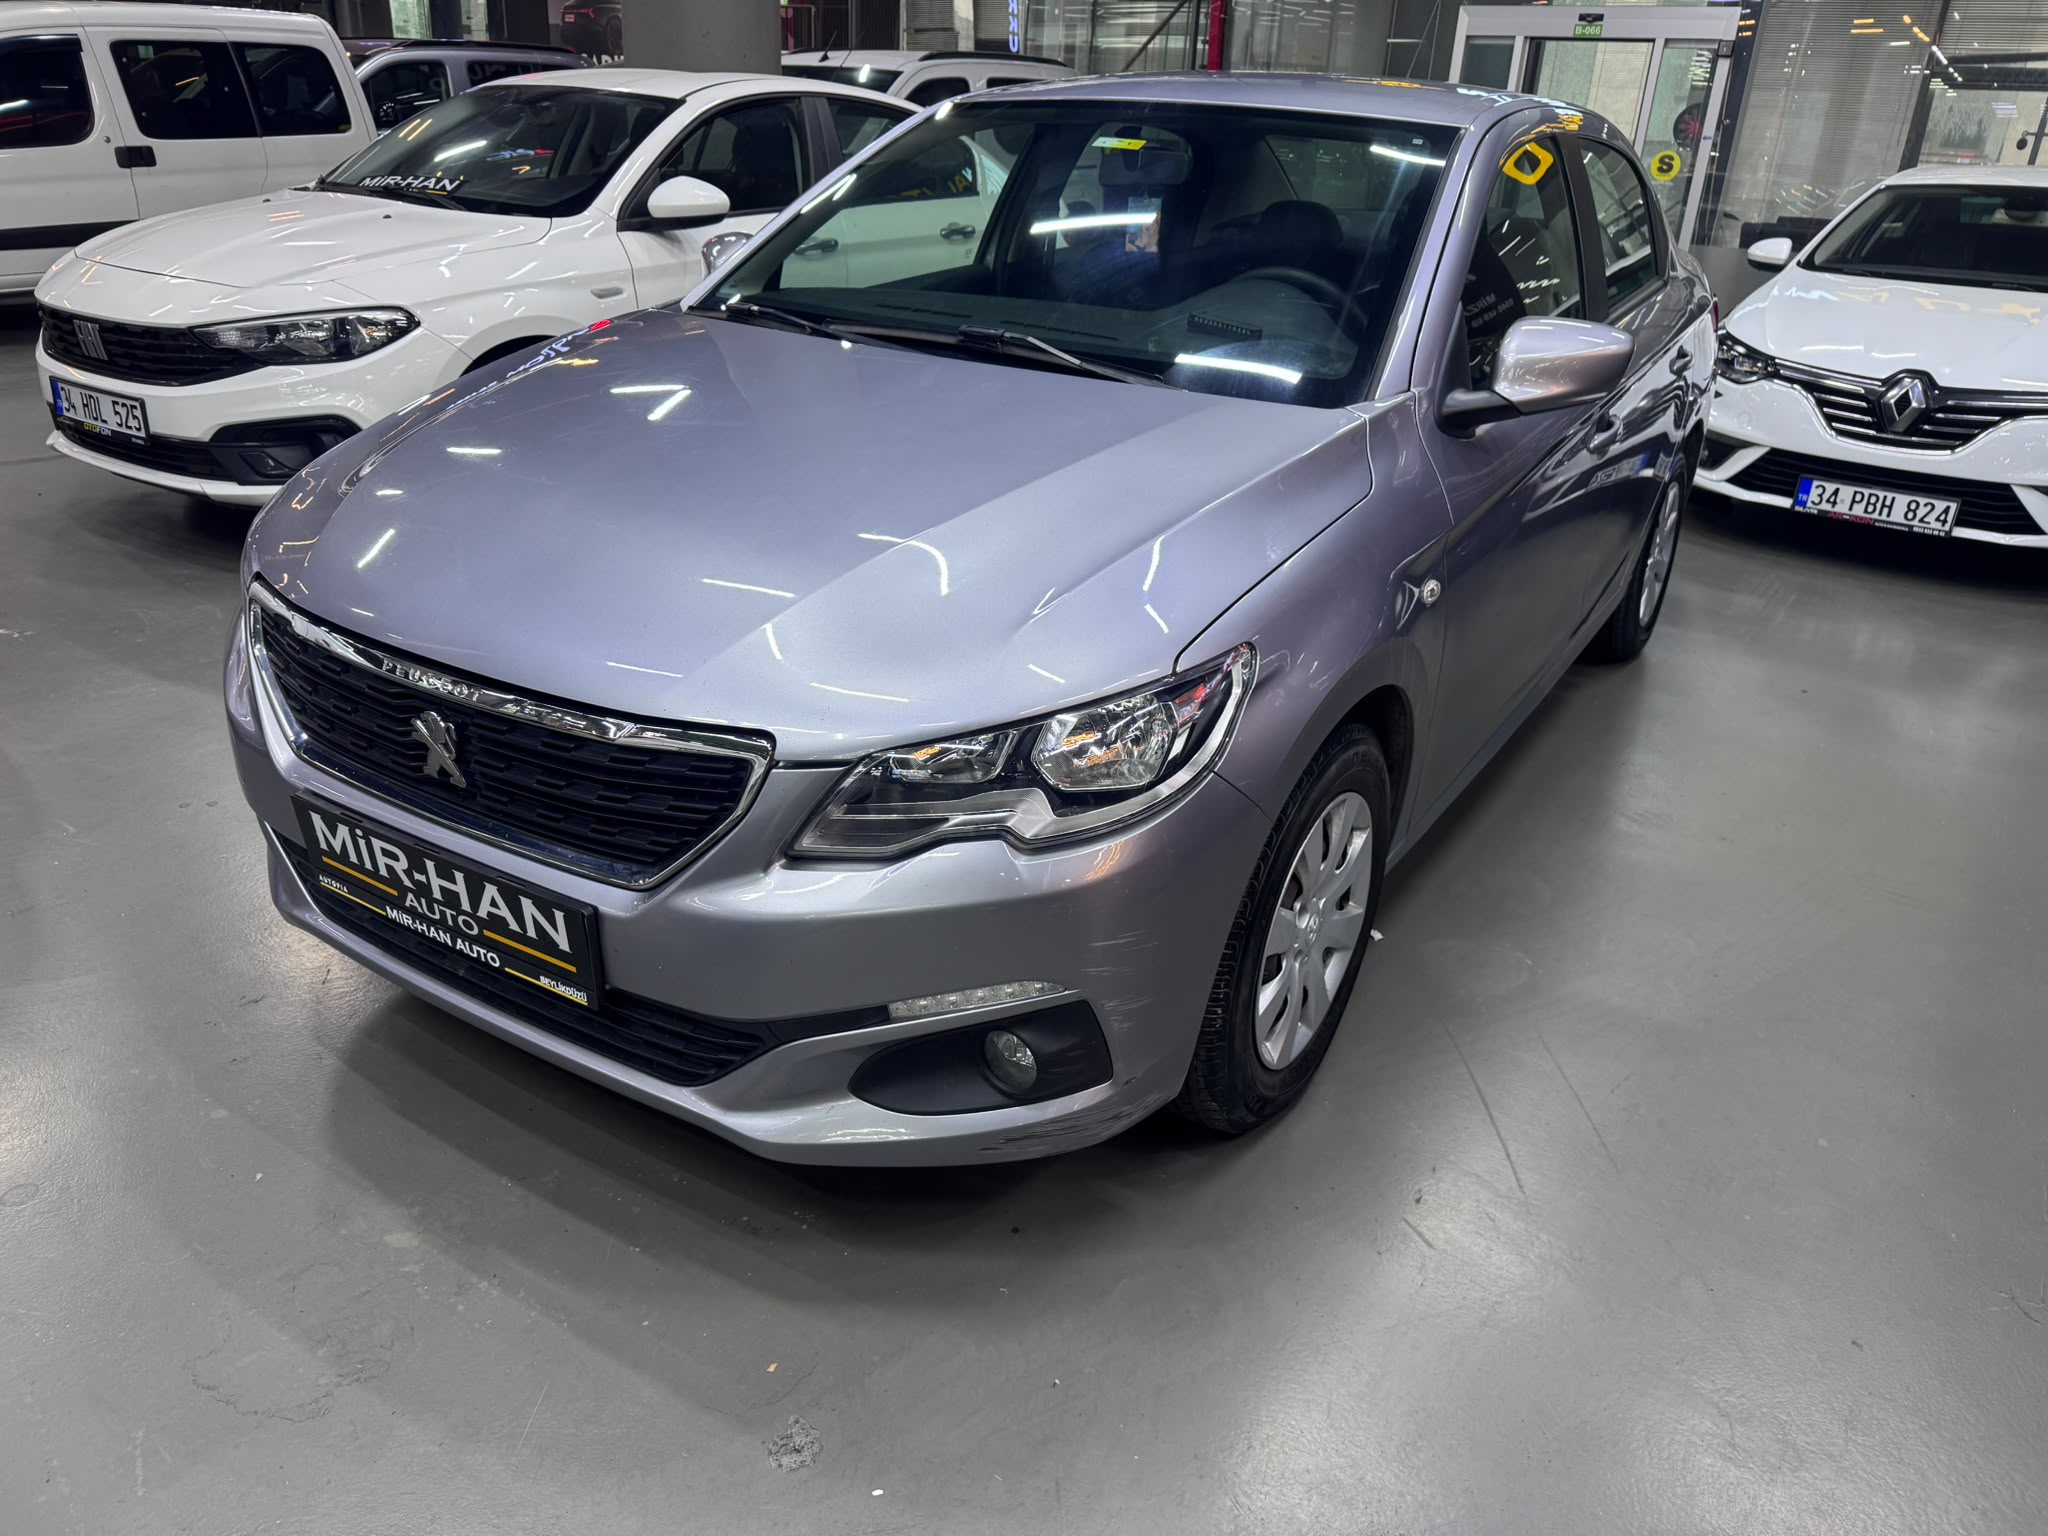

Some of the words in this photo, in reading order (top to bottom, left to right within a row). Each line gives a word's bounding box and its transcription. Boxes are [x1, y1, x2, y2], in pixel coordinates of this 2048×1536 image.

[1575, 25, 1602, 35] B-066
[1656, 154, 1675, 174] S
[60, 386, 77, 415] 34
[79, 391, 108, 424] HDL
[111, 399, 142, 432] 525
[1810, 484, 1841, 509] 34
[1848, 490, 1896, 518] PBH
[1903, 499, 1952, 528] 824
[382, 657, 484, 702] PEUGEOT
[404, 891, 480, 937] AUTO
[455, 937, 501, 968] AUTO
